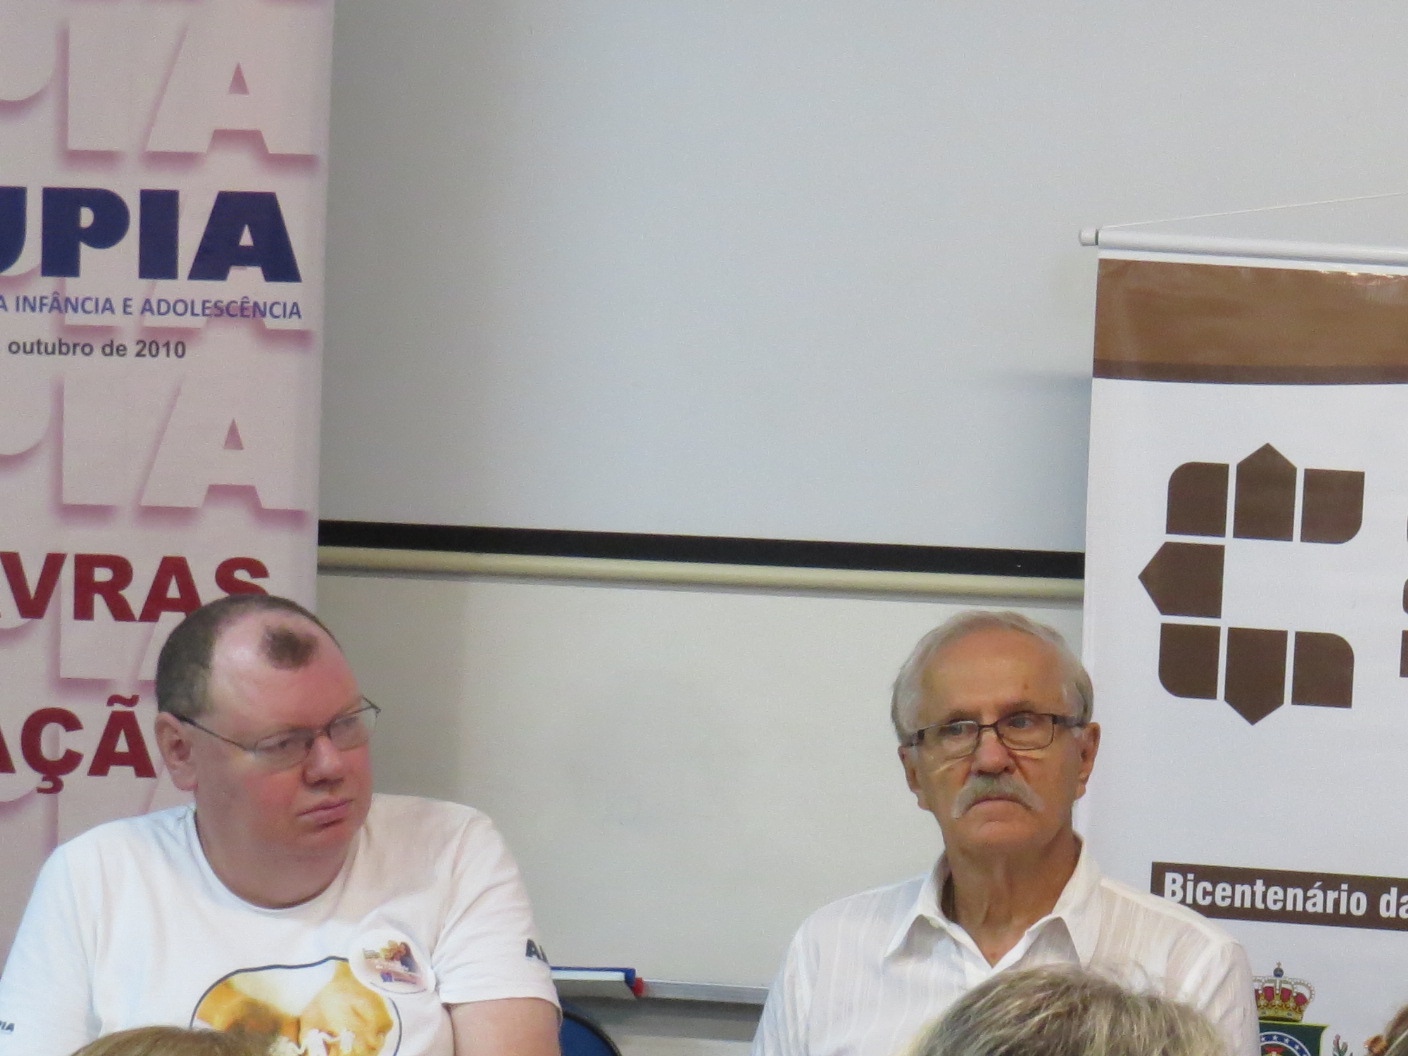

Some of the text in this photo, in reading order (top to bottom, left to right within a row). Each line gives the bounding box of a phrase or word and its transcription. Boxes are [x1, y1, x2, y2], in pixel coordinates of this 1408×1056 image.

[15, 291, 116, 315] INFÂNCIA
[122, 297, 133, 316] E
[140, 296, 302, 320] ADOLESCÊNCIA
[8, 338, 187, 358] outubro de 2010
[1163, 872, 1367, 916] Bicentenário
